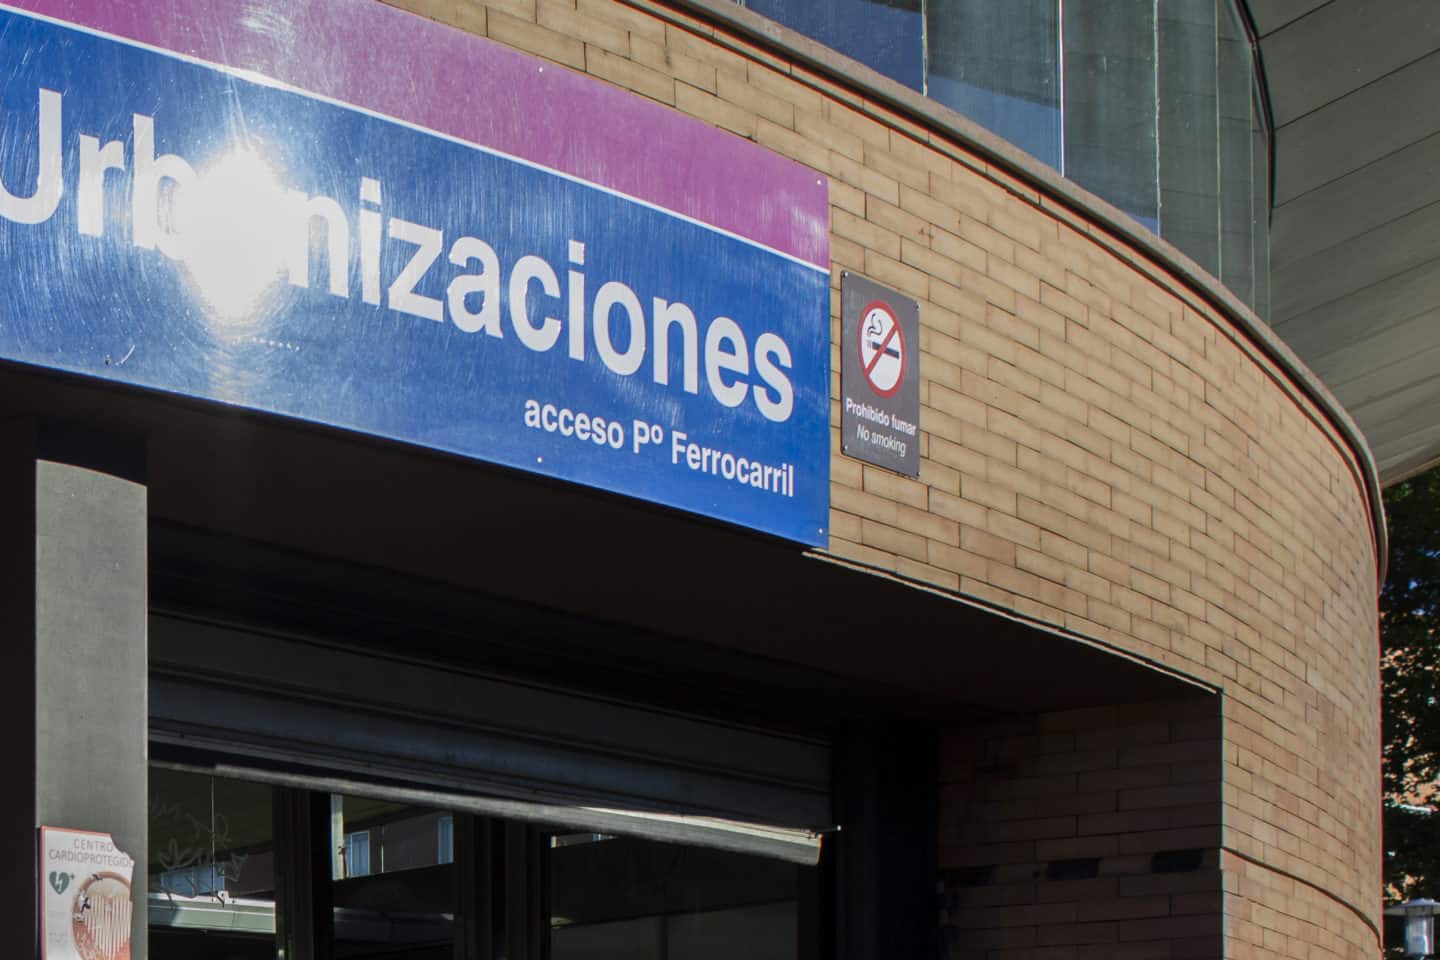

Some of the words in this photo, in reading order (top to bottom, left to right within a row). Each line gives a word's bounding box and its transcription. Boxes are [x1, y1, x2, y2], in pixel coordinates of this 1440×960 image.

[845, 396, 890, 427] Prohibido
[891, 413, 917, 437] fumar
[524, 399, 625, 449] acceso
[671, 430, 795, 498] Ferrocarril
[856, 423, 870, 441] No
[871, 431, 907, 458] smoking
